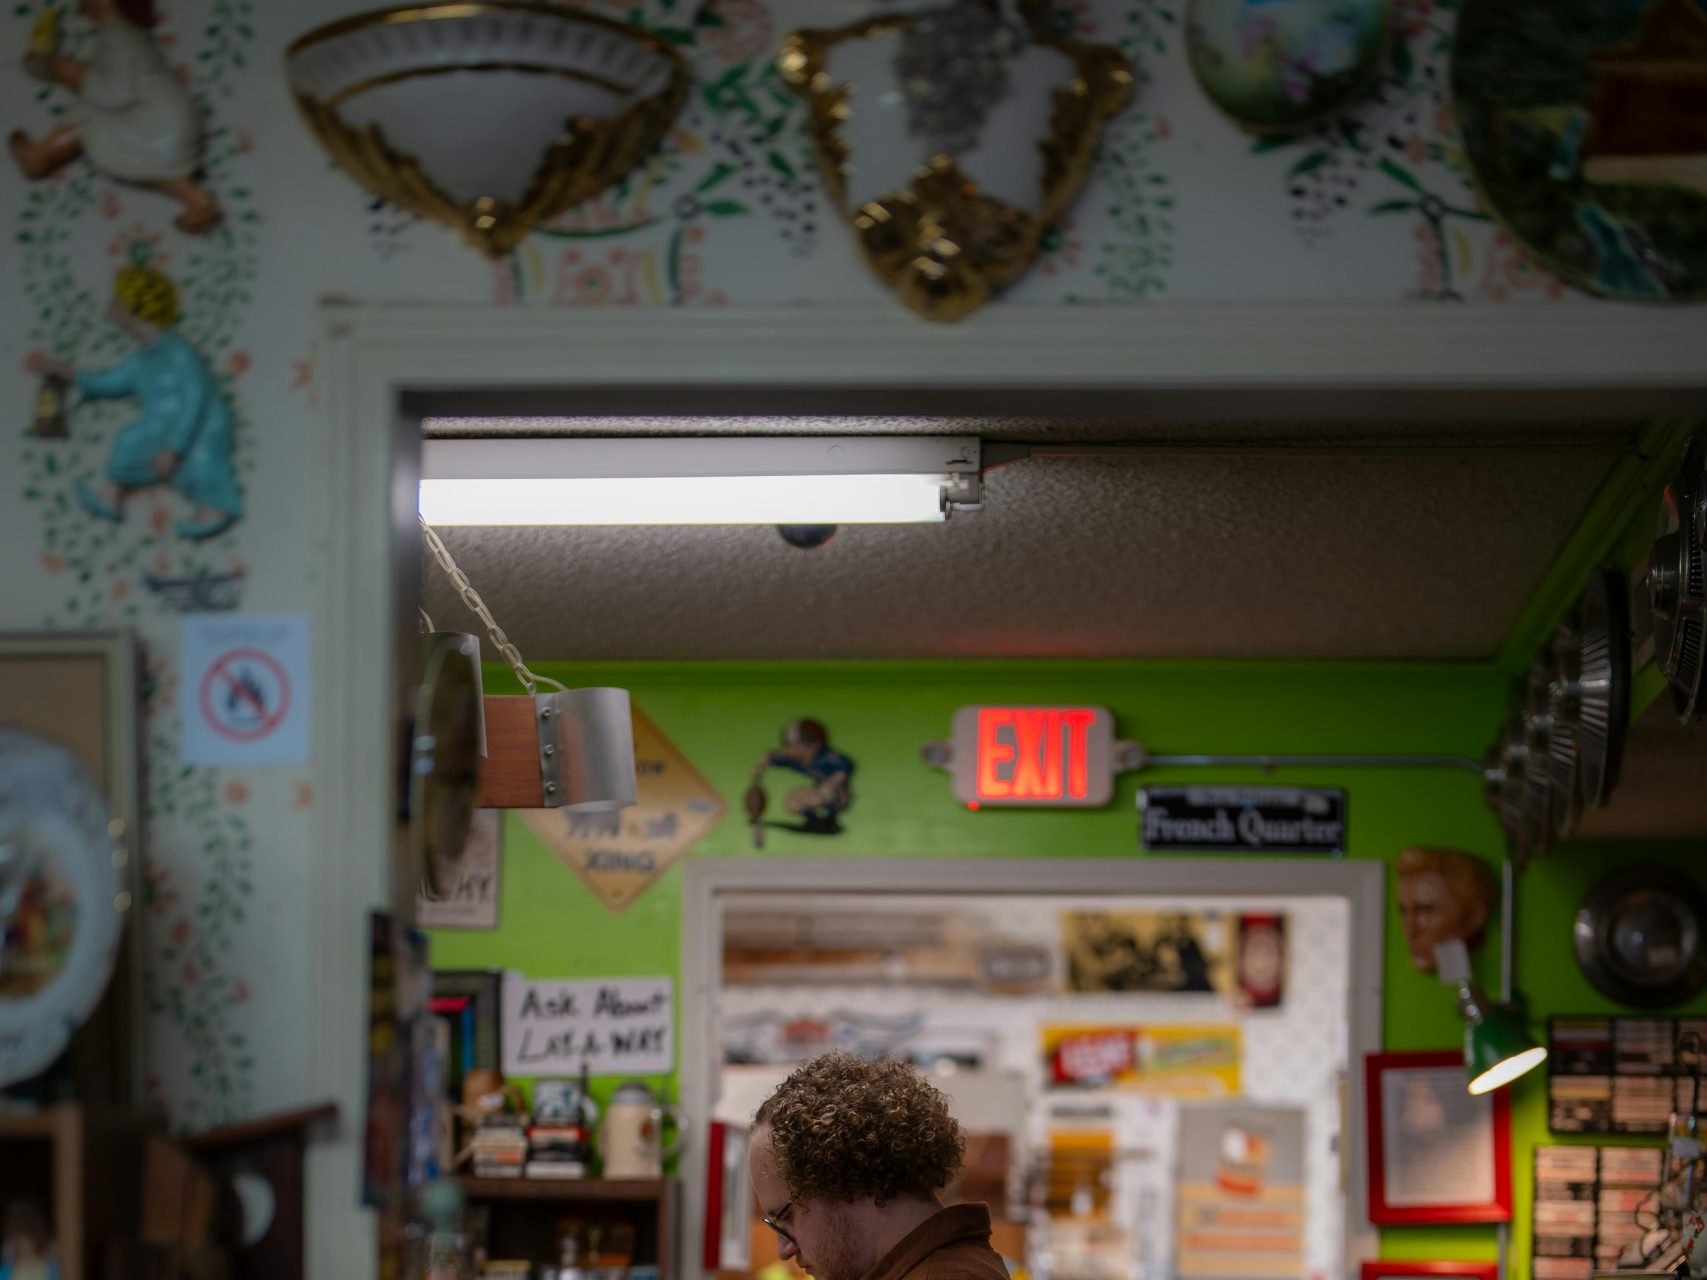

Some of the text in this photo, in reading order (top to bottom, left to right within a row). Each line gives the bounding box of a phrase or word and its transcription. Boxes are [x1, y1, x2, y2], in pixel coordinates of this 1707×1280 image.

[976, 708, 1096, 799] EXIT
[1144, 805, 1343, 847] French Quarter
[518, 985, 578, 1019] Ask
